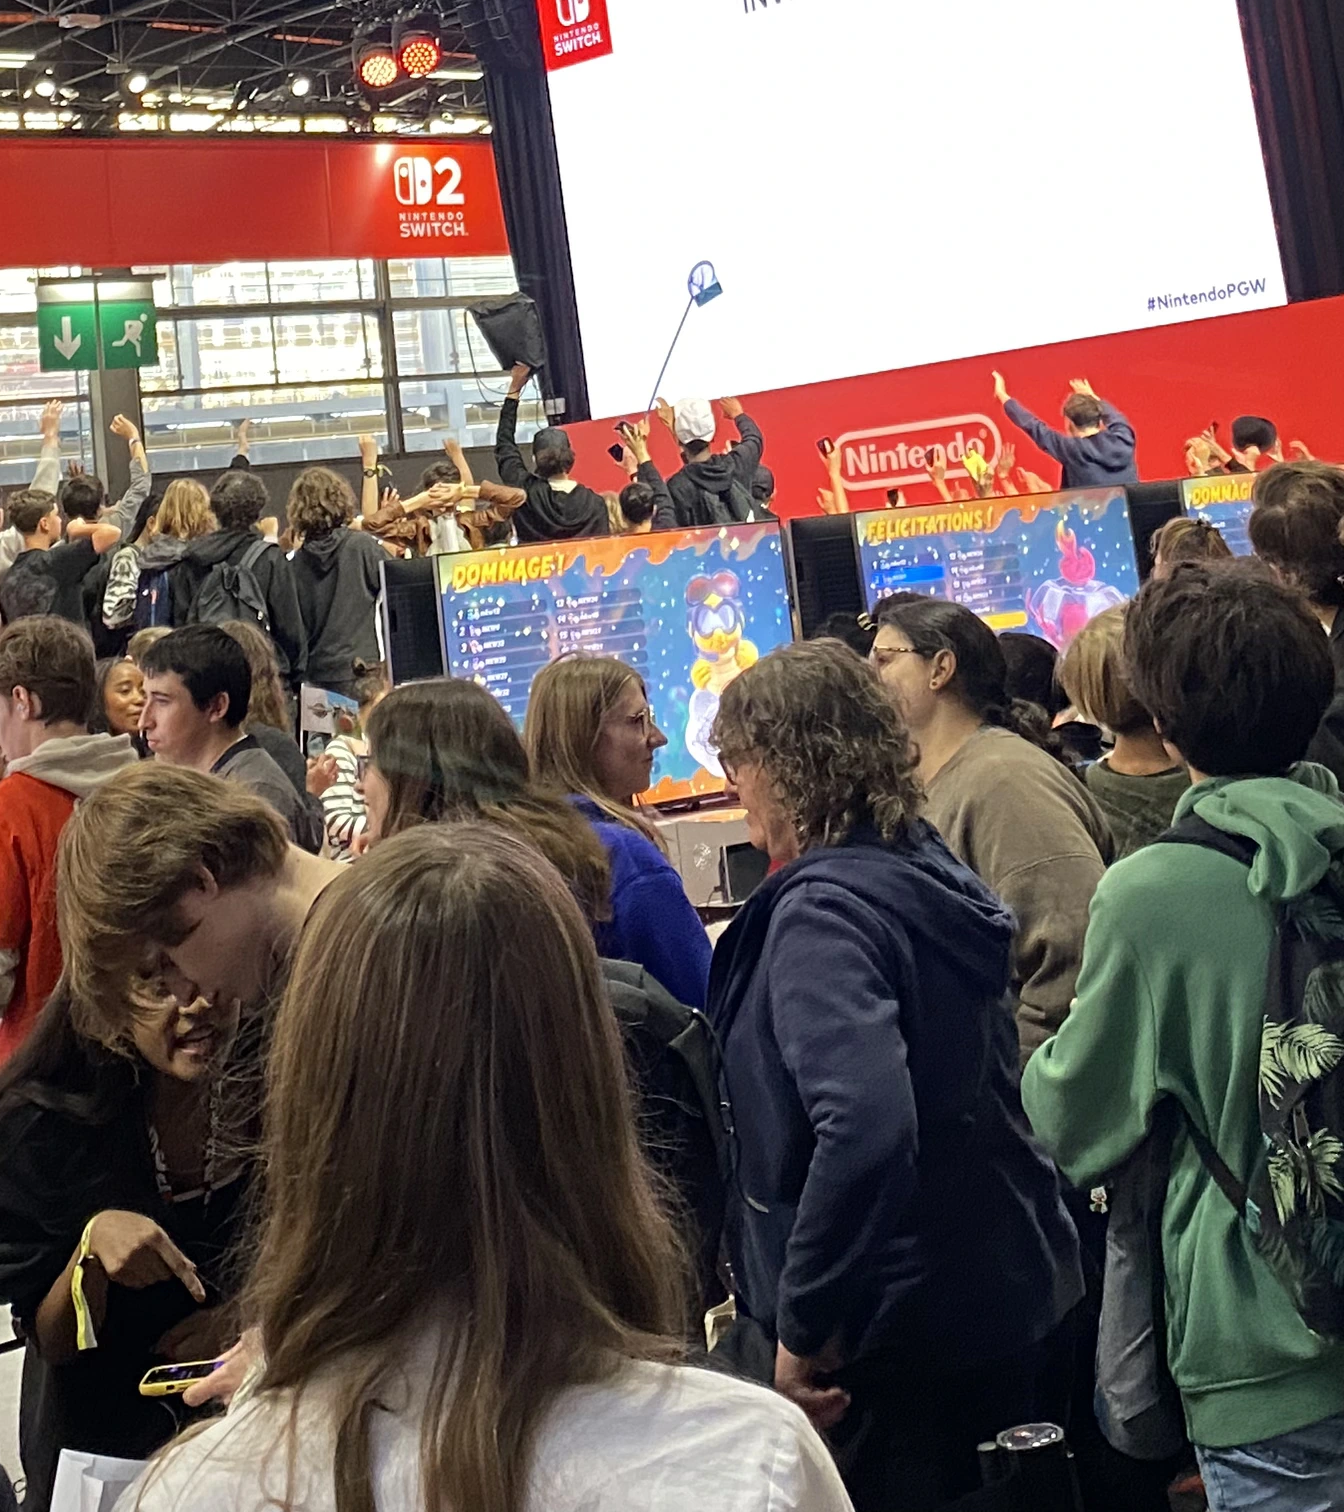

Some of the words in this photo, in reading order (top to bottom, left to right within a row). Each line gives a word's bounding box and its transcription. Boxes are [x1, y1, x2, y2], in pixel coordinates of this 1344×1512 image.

[553, 22, 600, 43] NINTENDO
[554, 30, 602, 57] SWITCH
[398, 210, 465, 222] NINTENDO
[399, 221, 466, 239] SWITCH
[1146, 277, 1267, 313] #NintendoPGW
[866, 510, 984, 540] FÉLICITATIONS
[452, 555, 554, 589] DOMMAGE
